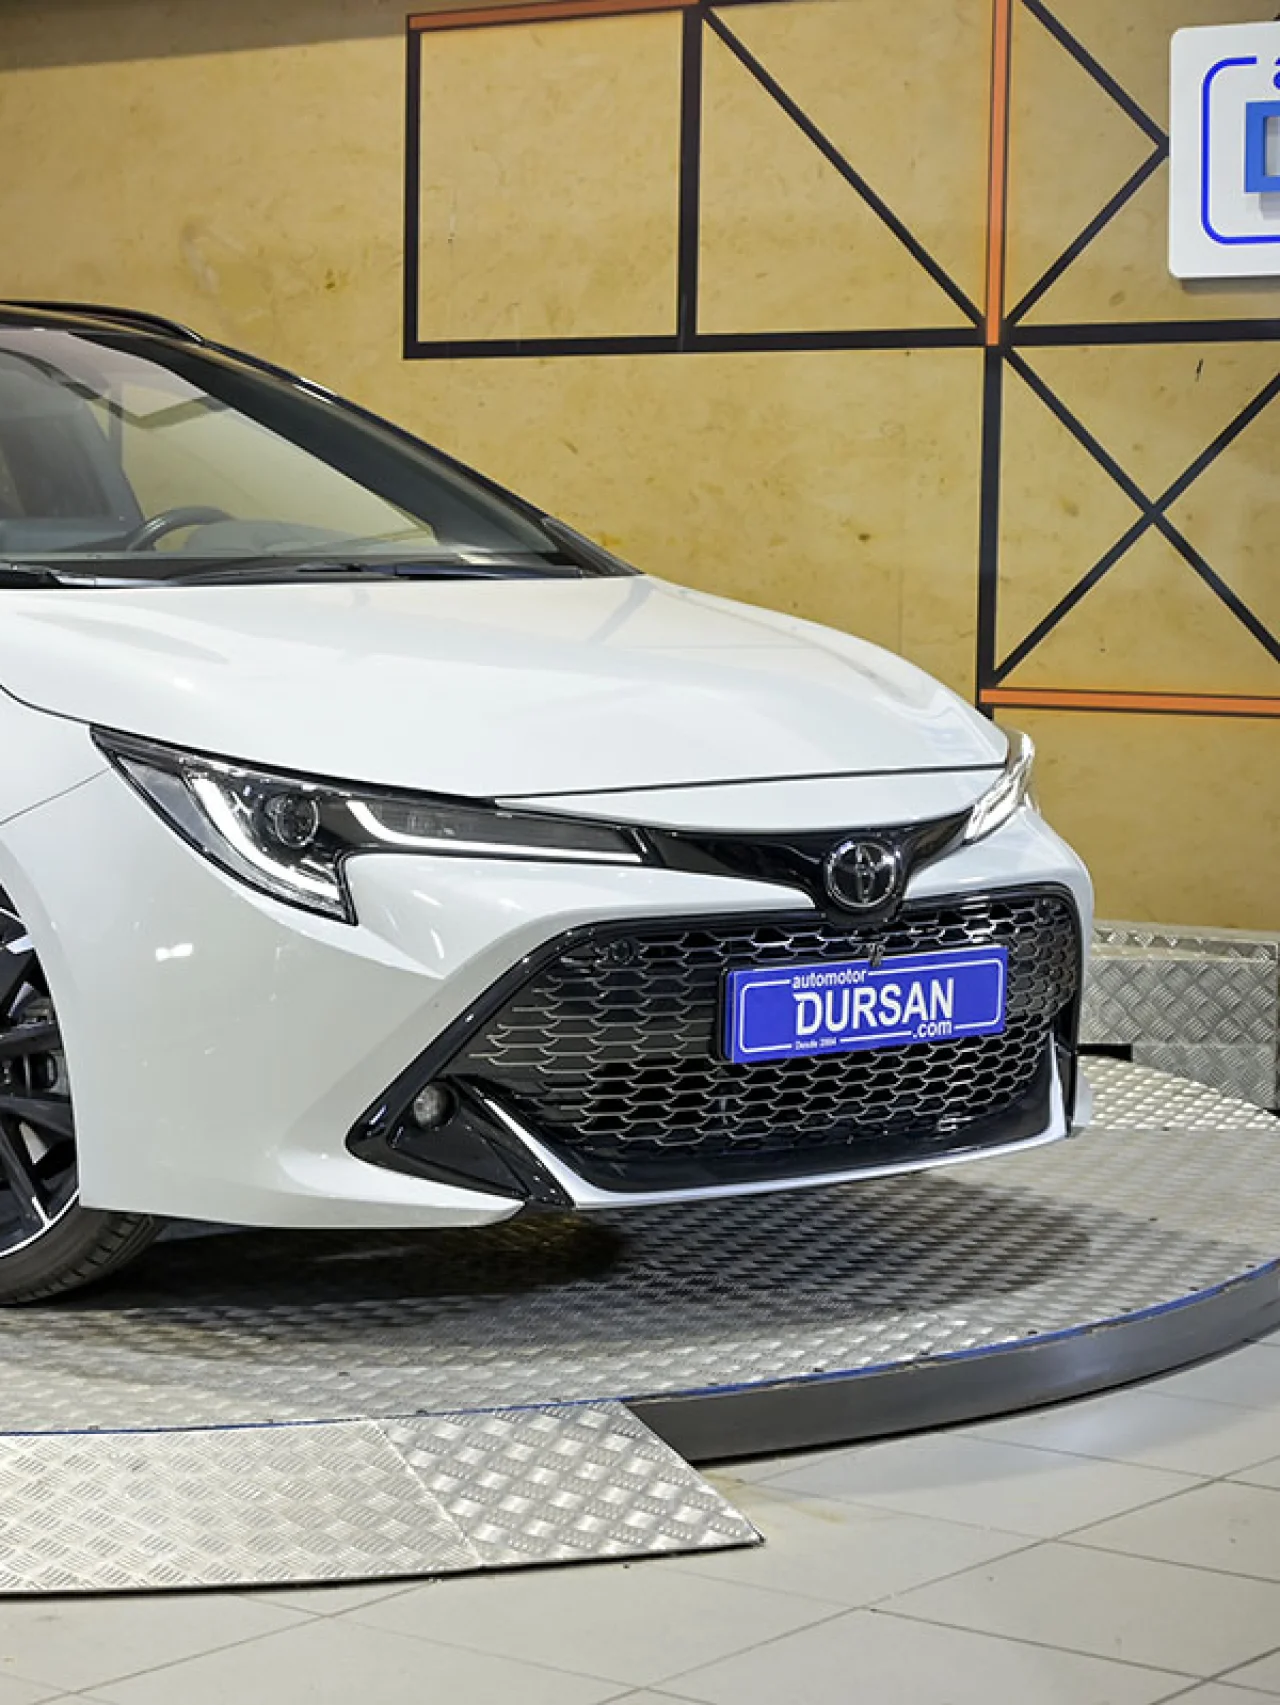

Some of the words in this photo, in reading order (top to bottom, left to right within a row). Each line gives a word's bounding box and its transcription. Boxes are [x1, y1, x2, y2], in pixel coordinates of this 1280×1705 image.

[793, 968, 867, 989] automotor
[793, 976, 954, 1036] DURSAN
[912, 1020, 952, 1039] .com
